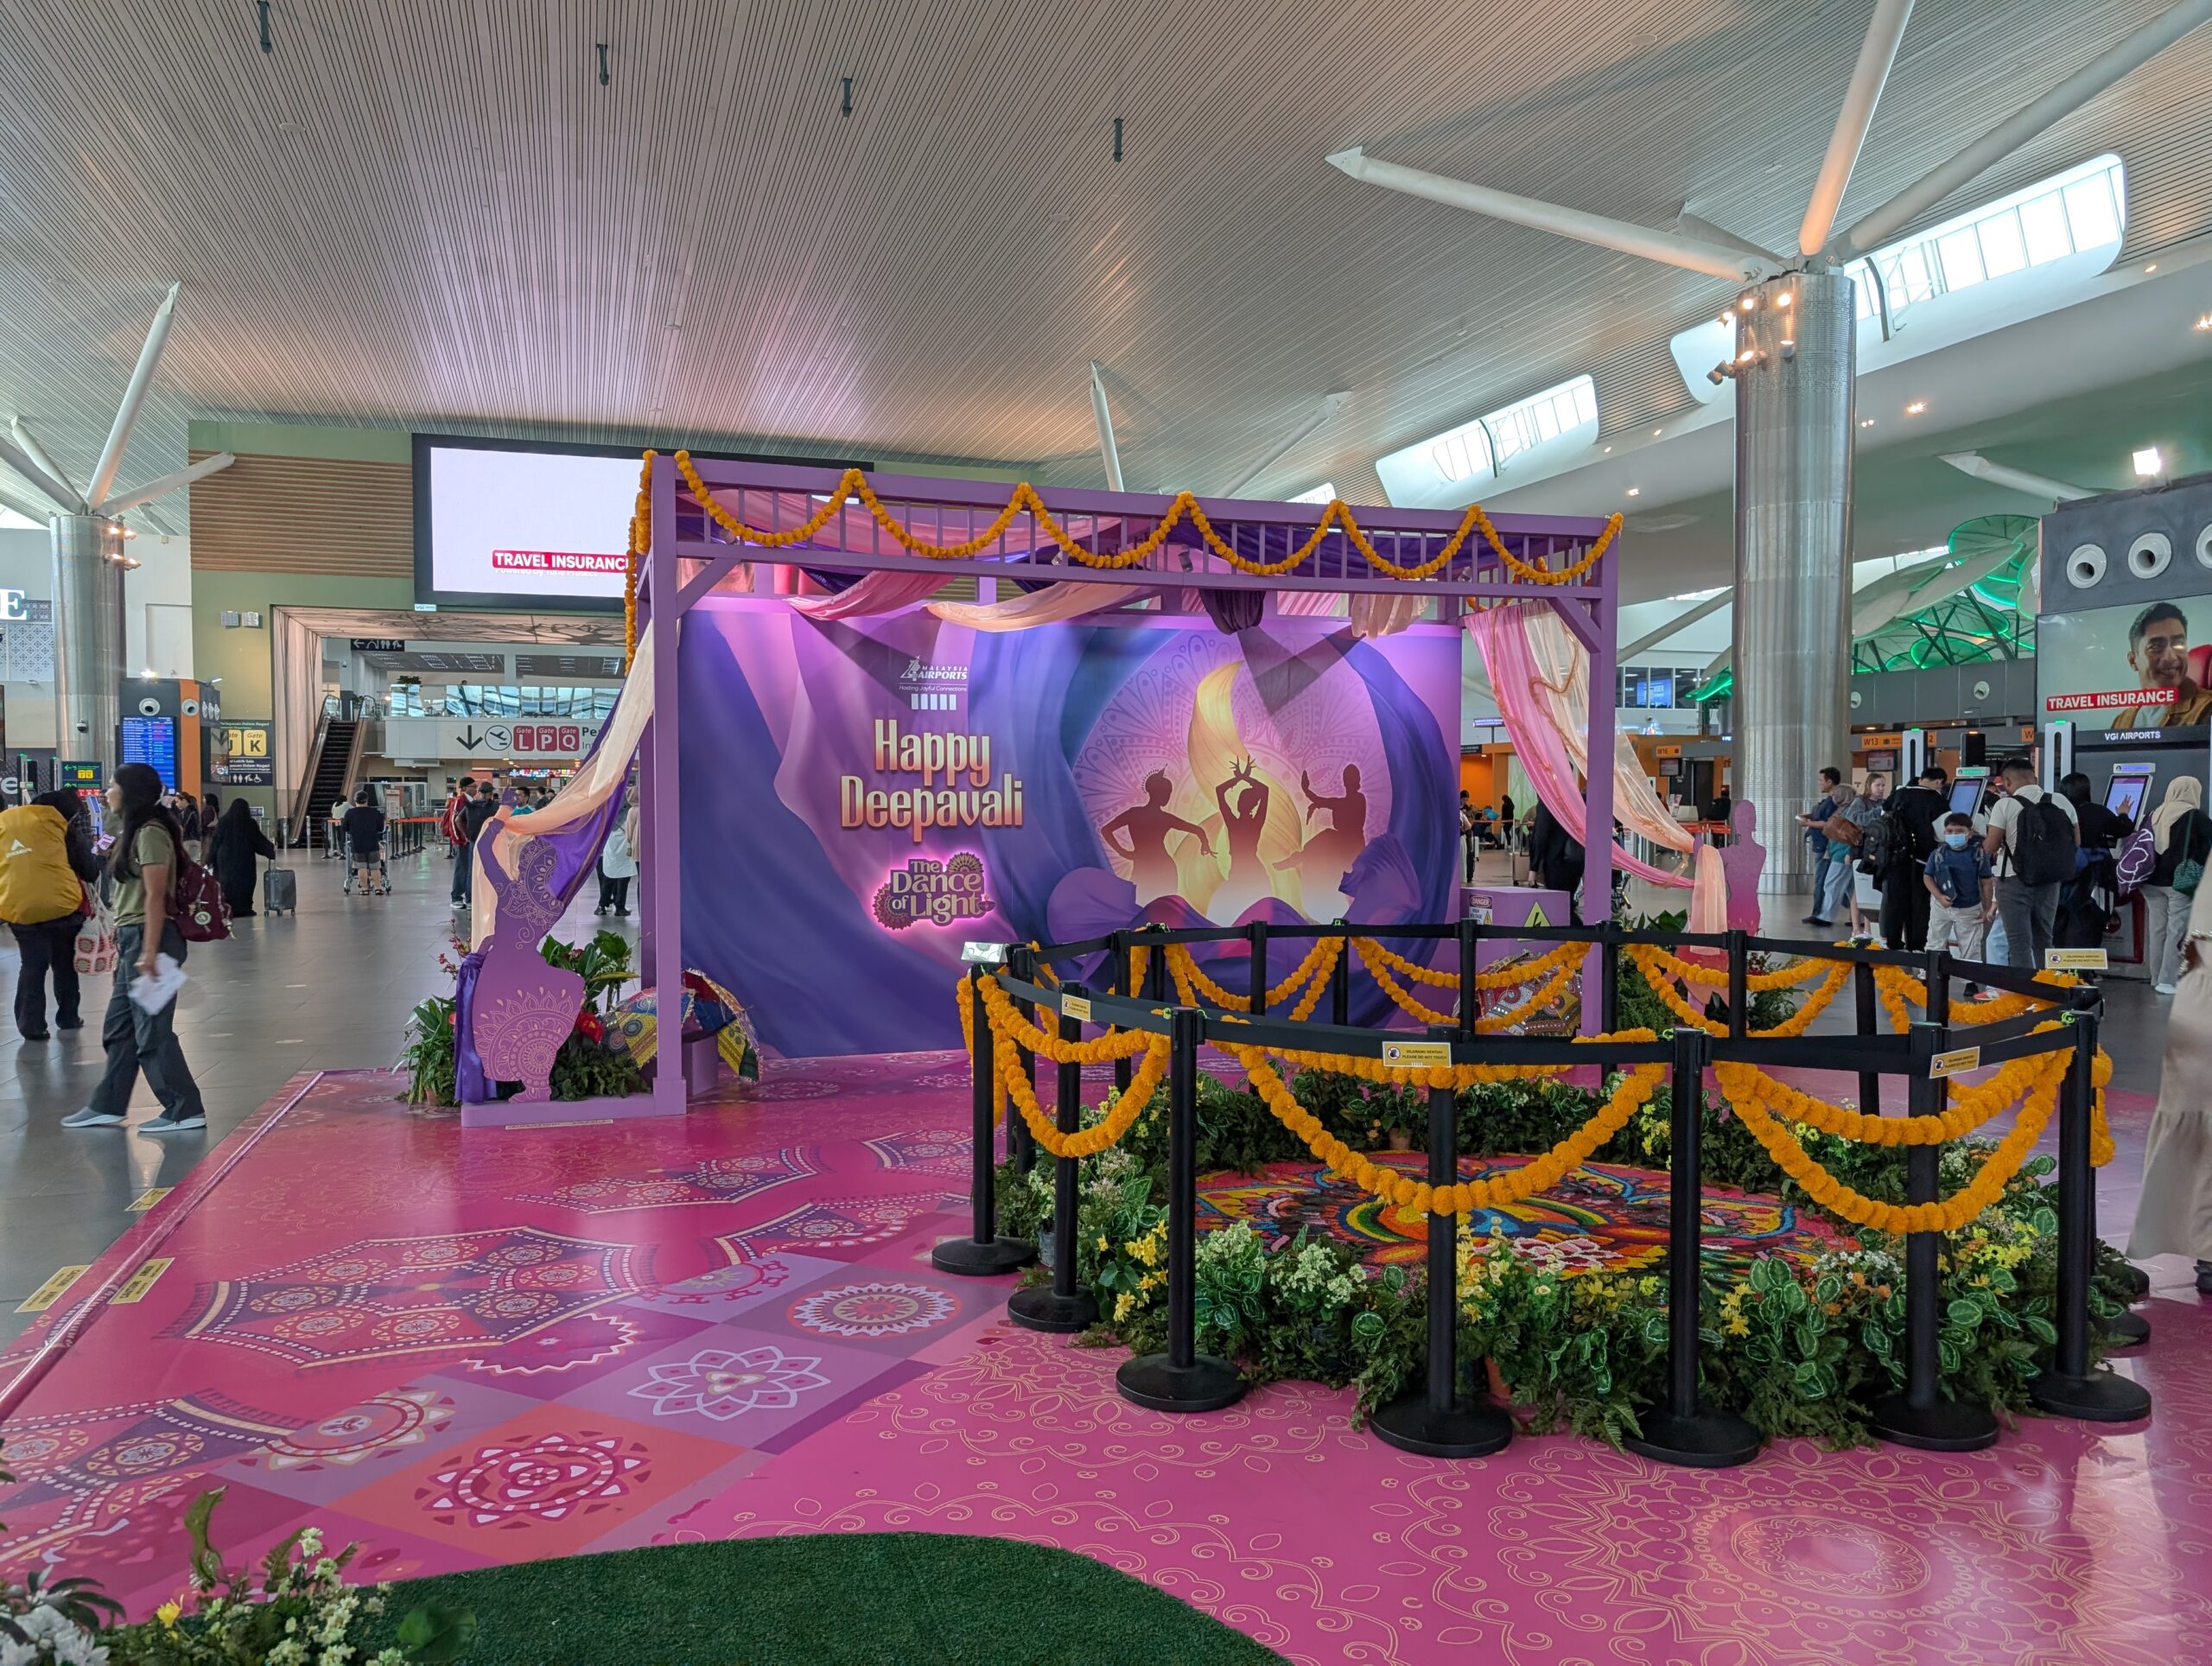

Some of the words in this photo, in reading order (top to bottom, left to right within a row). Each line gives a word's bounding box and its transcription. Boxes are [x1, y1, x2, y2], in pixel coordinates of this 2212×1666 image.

[494, 553, 549, 568] TRAVEL
[918, 671, 968, 680] AIRPORTS
[2048, 696, 2094, 709] TRAVEL
[2096, 690, 2175, 707] INSURANCE
[519, 734, 530, 750] L
[541, 734, 553, 750] P
[563, 734, 575, 750] Q
[2104, 732, 2119, 741] VGI
[2120, 730, 2162, 741] AIRPORTS
[250, 740, 261, 752] K
[874, 719, 991, 788] Happy
[841, 773, 1023, 843] Deepavali
[910, 861, 940, 874] The
[893, 871, 982, 893] Dance
[892, 895, 910, 910] of
[910, 891, 983, 924] Light
[1471, 898, 1490, 906] DANGER
